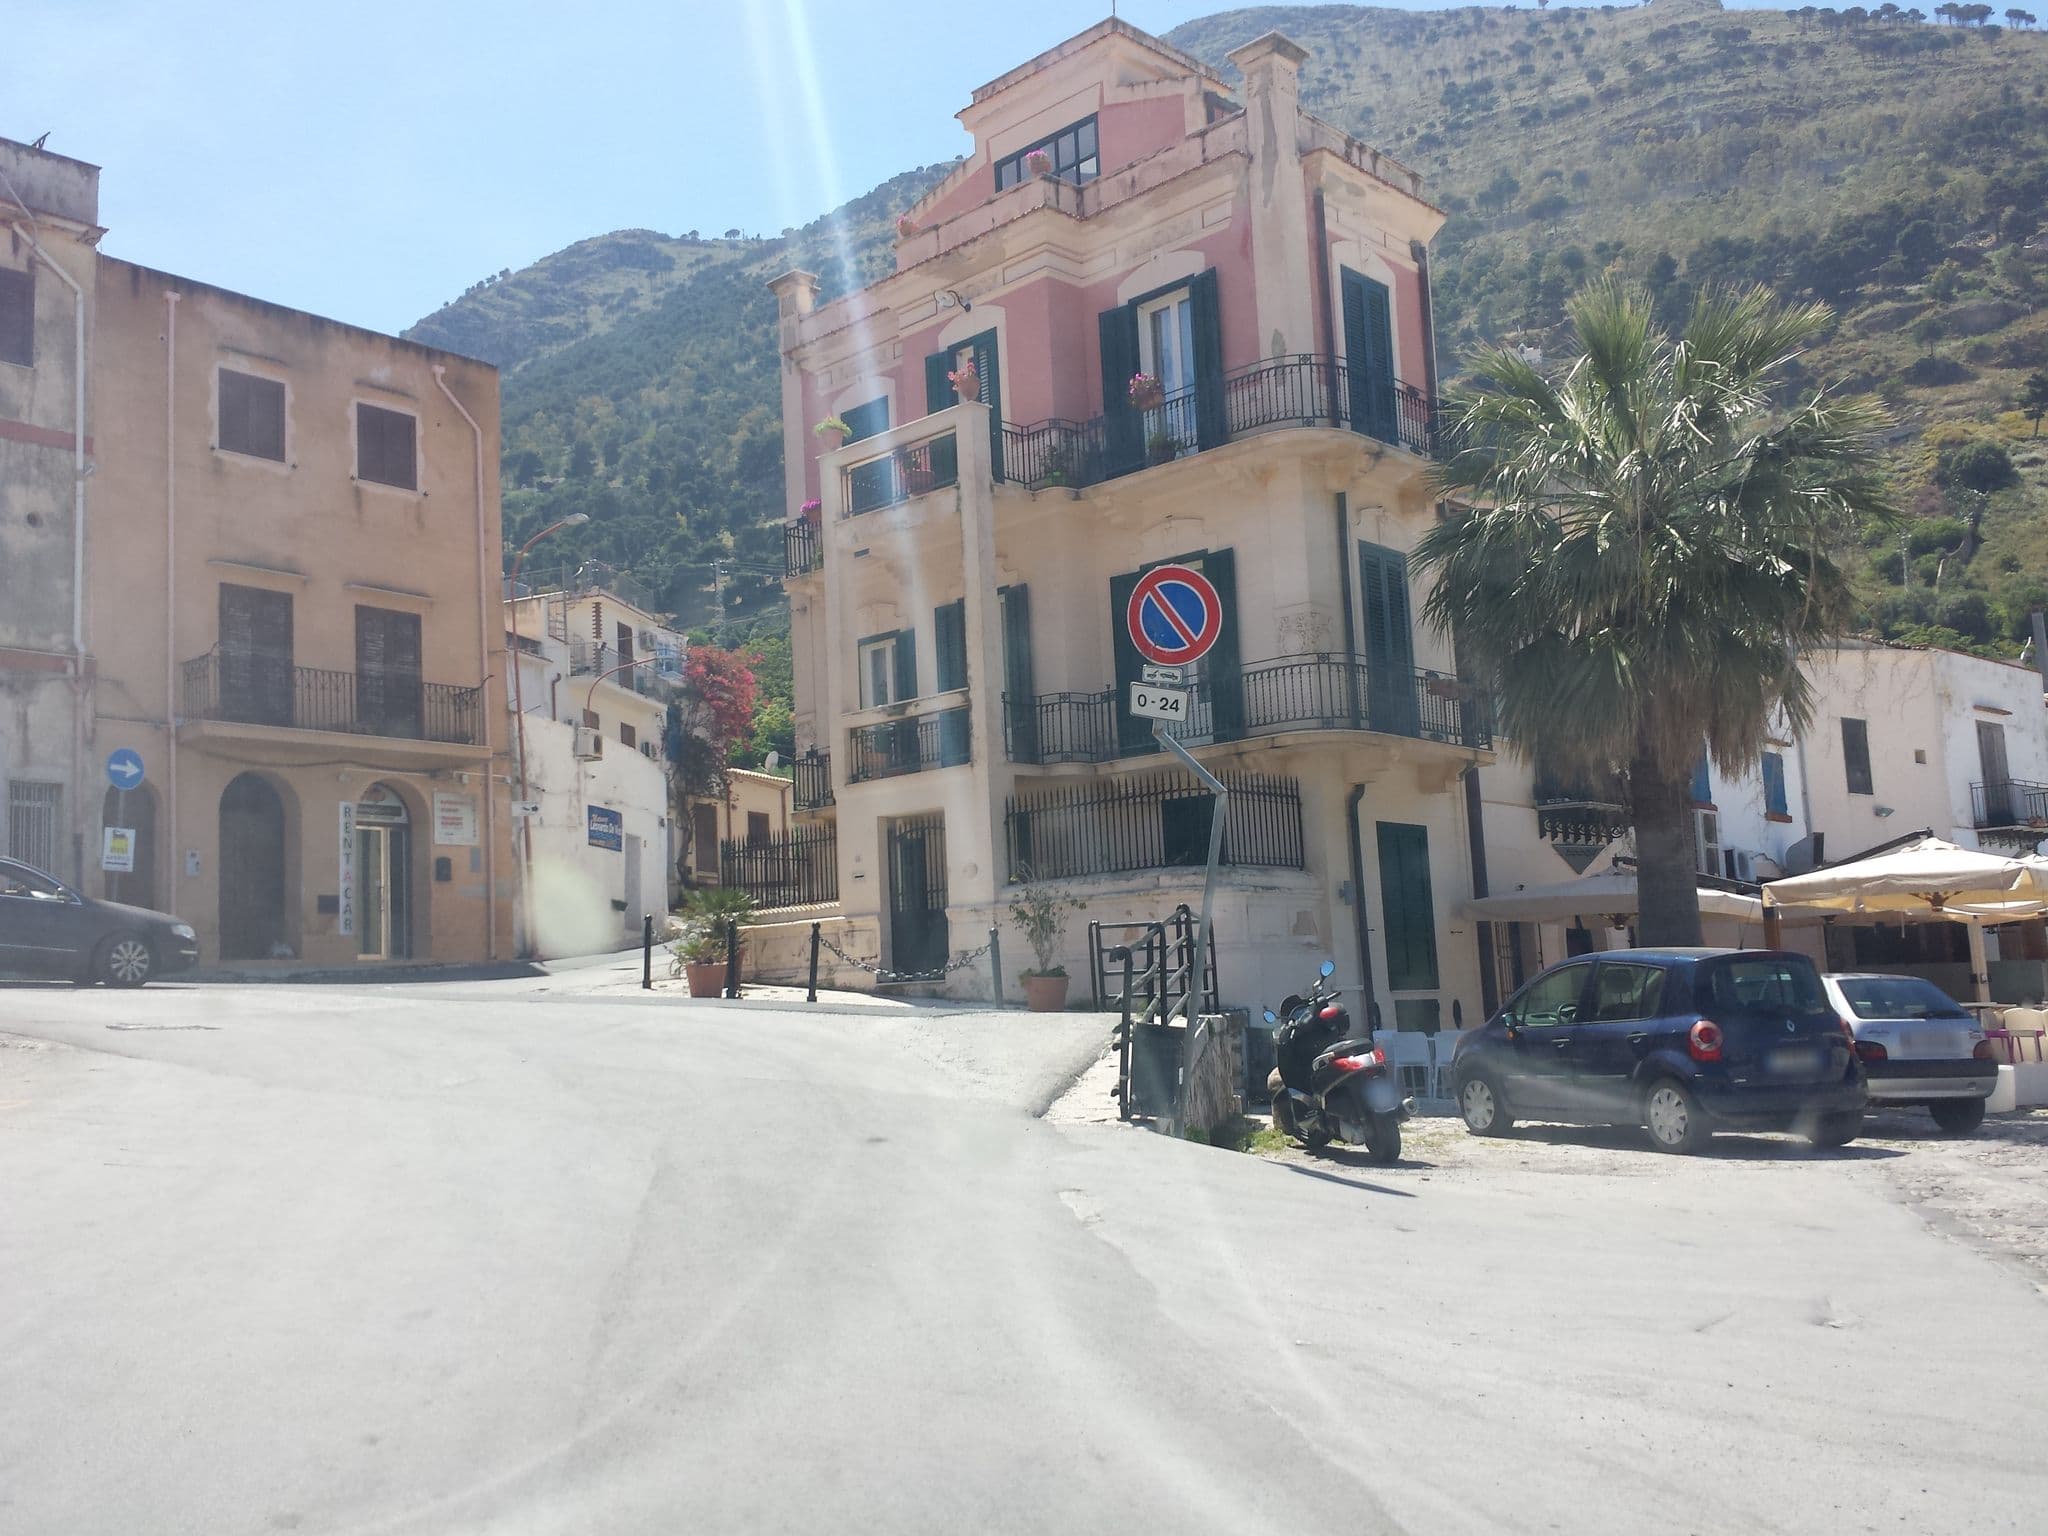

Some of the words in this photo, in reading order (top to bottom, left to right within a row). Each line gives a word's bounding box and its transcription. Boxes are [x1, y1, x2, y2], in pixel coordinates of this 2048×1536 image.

[1138, 694, 1146, 707] 0
[1159, 697, 1180, 712] 24
[343, 807, 351, 864] RENT
[343, 887, 351, 931] CAR
